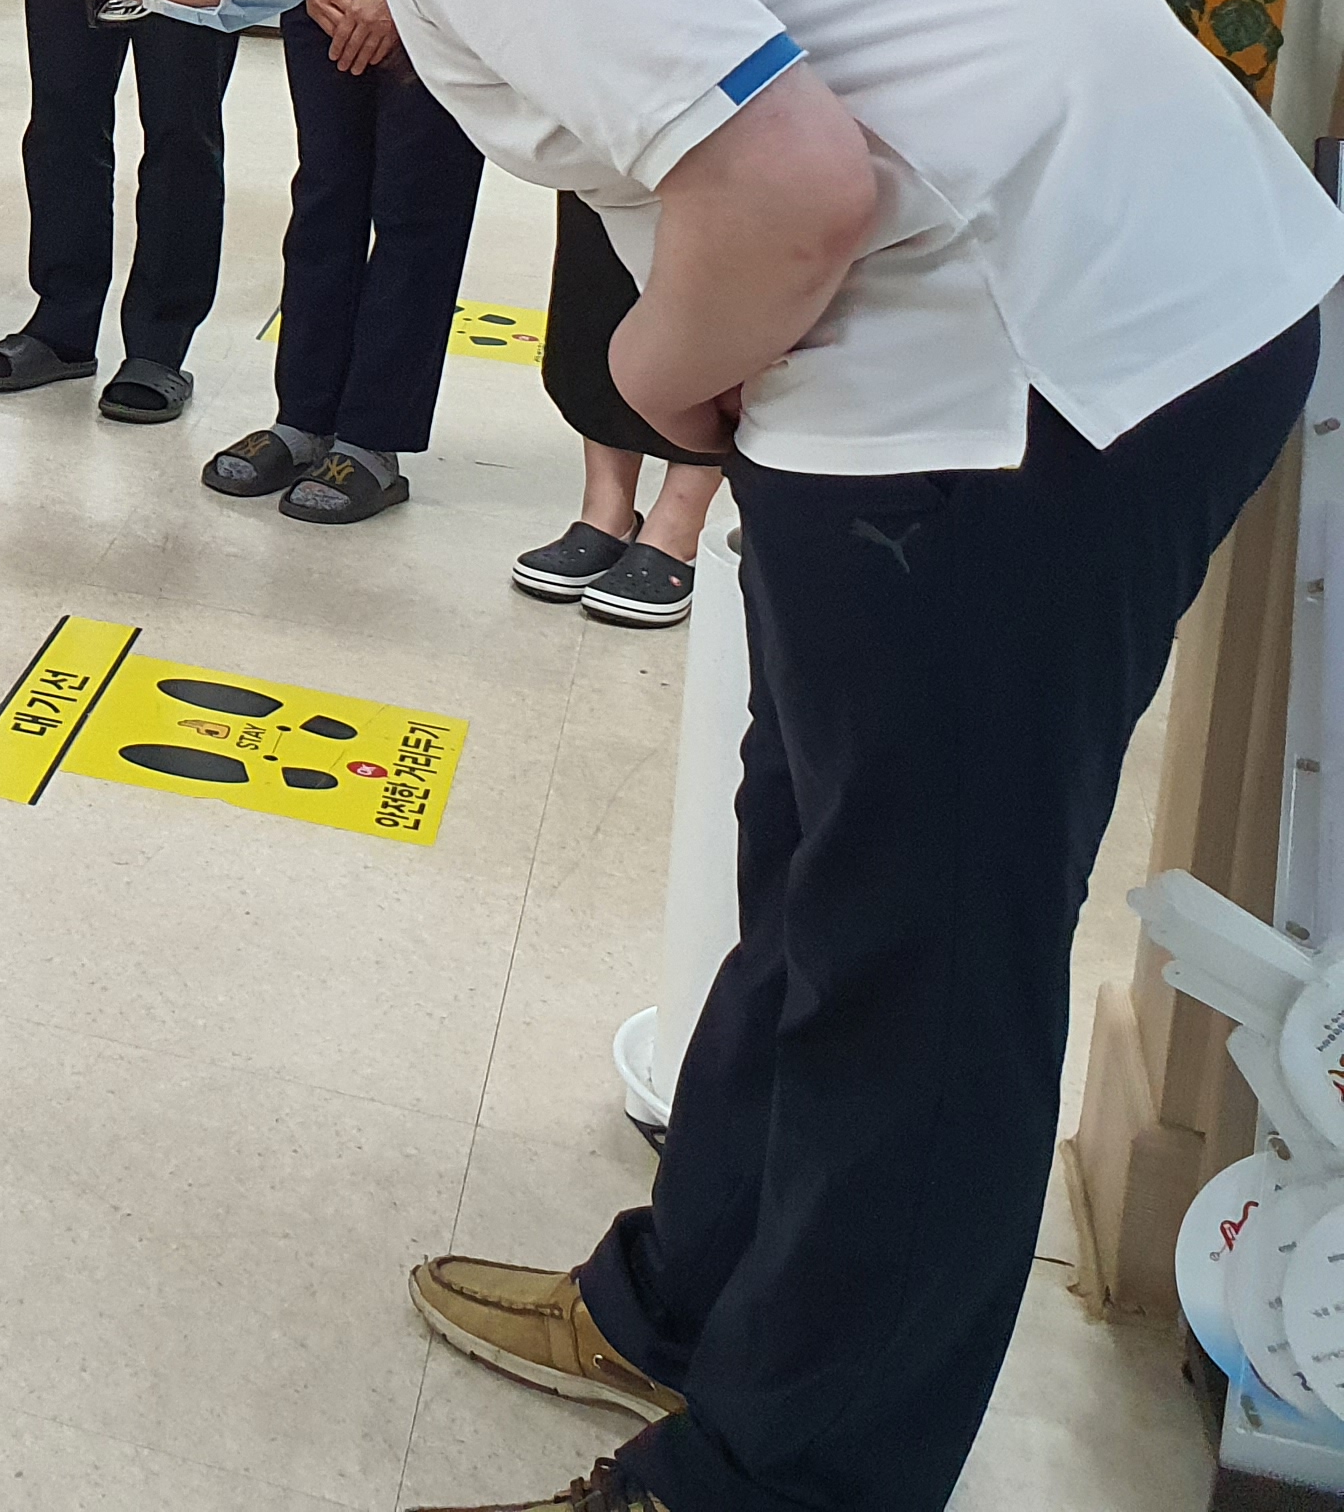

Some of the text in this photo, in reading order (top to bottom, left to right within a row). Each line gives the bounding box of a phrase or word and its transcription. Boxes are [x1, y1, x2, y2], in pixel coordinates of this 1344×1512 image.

[11, 668, 90, 737] 대기선
[236, 723, 266, 750] STAY
[375, 721, 451, 831] 안전한 거리두기
